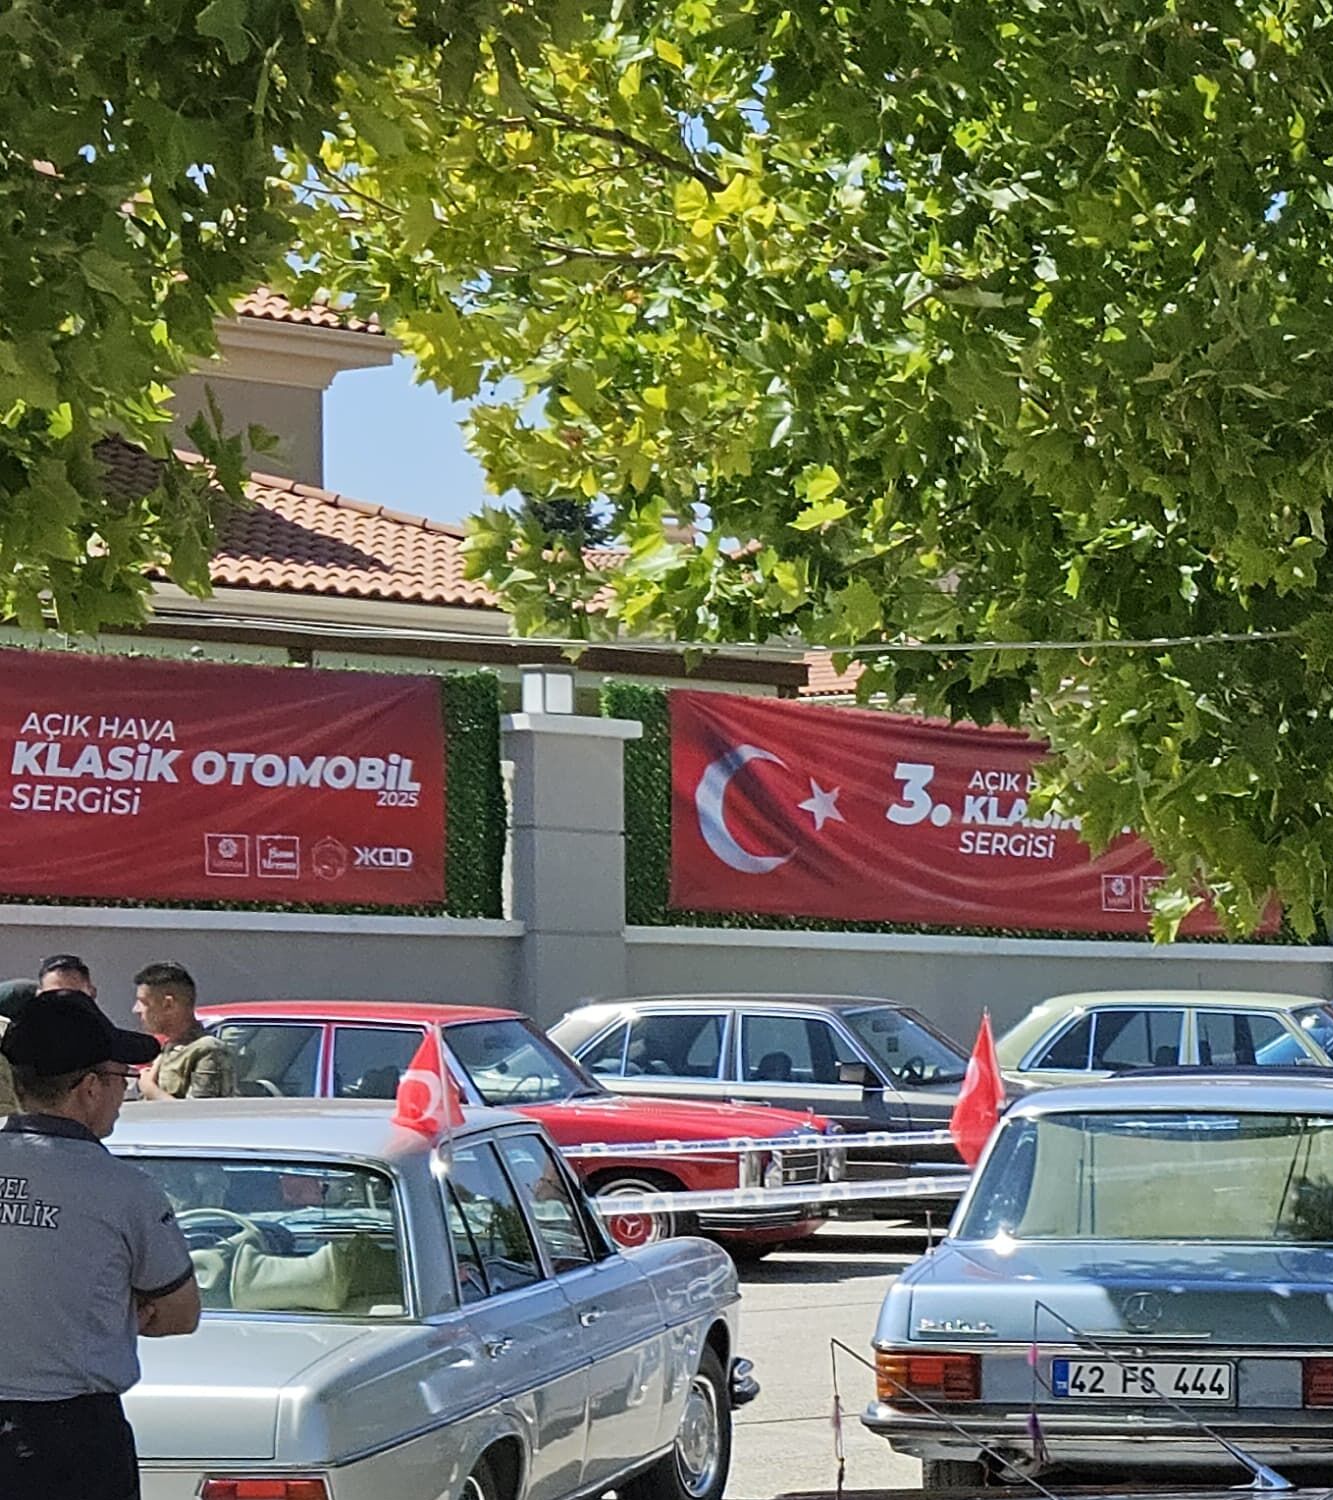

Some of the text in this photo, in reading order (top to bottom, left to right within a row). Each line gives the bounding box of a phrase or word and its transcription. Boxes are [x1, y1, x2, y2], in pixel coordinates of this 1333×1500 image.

[20, 712, 176, 742] AÇIK HAVA
[886, 762, 952, 828] 3.
[968, 770, 1020, 795] AÇIK
[376, 790, 418, 807] 2025
[1071, 1365, 1105, 1393] 42
[1122, 1366, 1157, 1394] FS
[1174, 1367, 1225, 1396] 444
